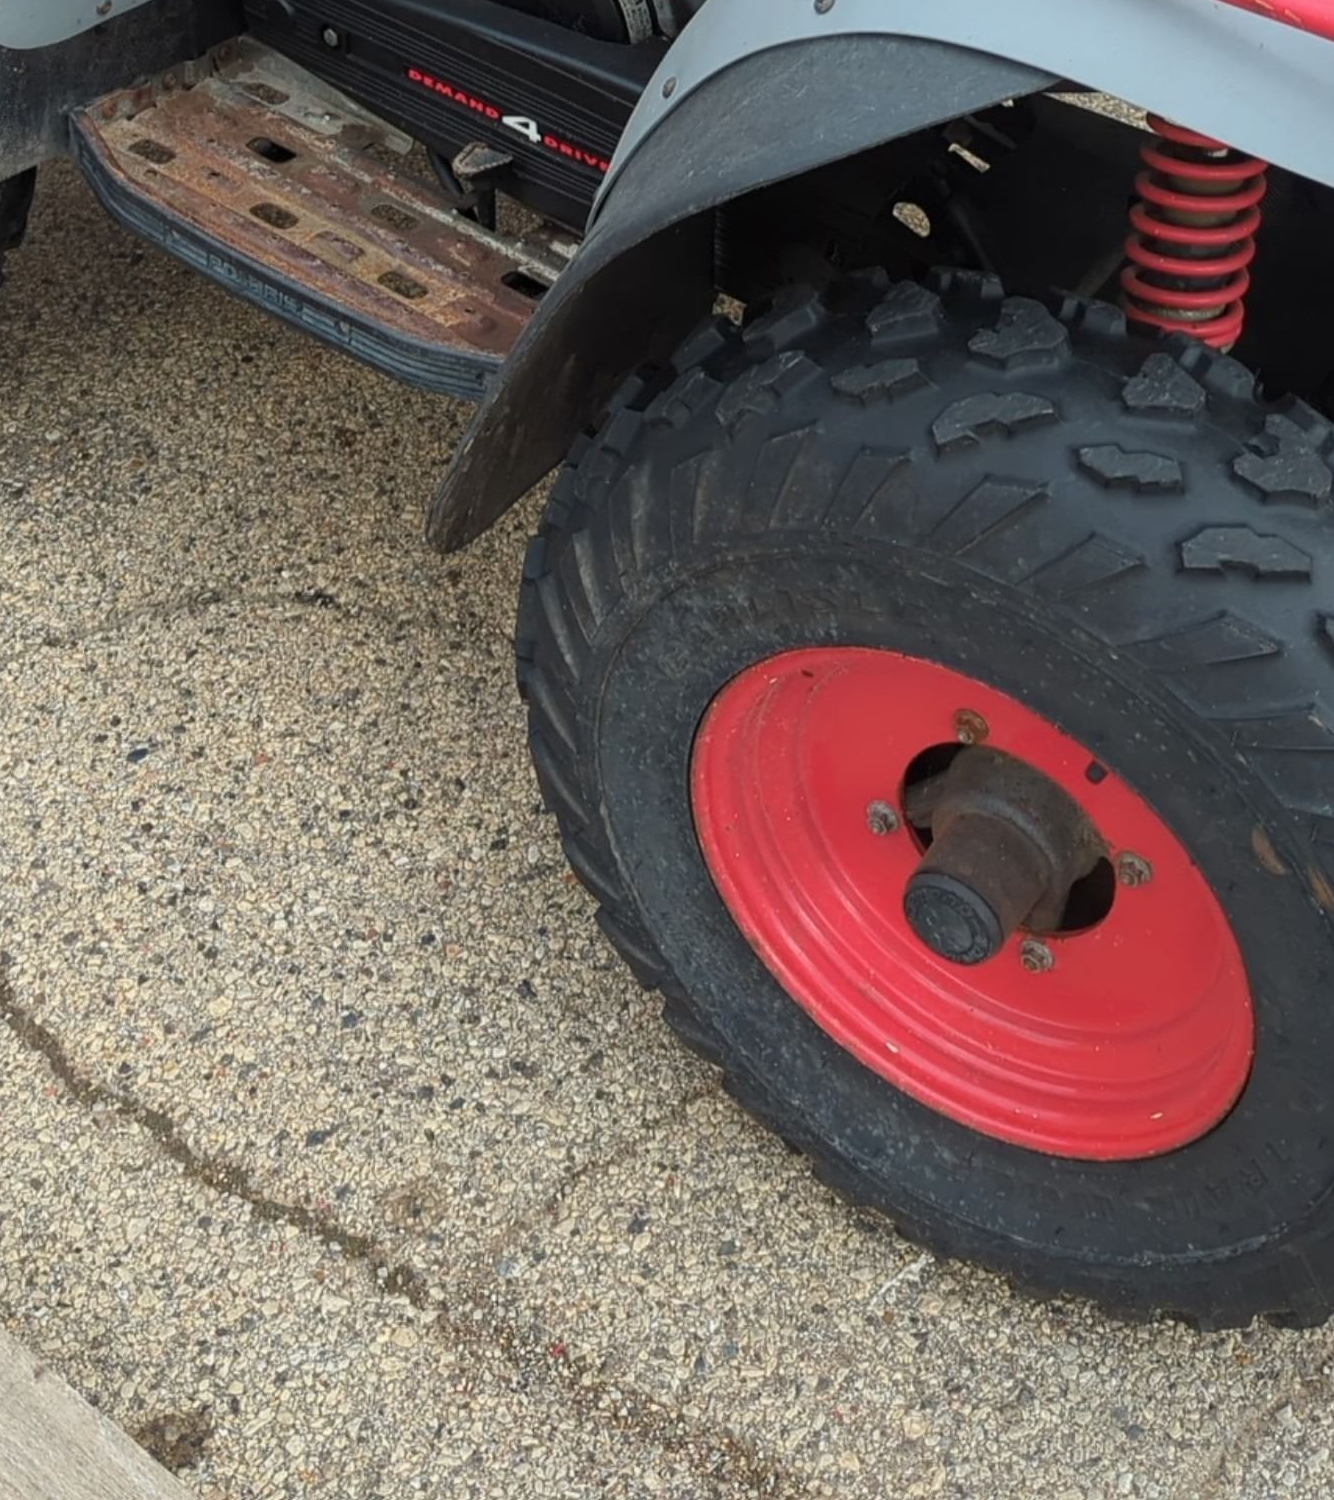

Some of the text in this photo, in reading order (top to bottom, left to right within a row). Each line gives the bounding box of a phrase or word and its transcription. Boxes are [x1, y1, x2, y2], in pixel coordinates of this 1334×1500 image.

[408, 68, 610, 173] DEMAND 4 DRIVE
